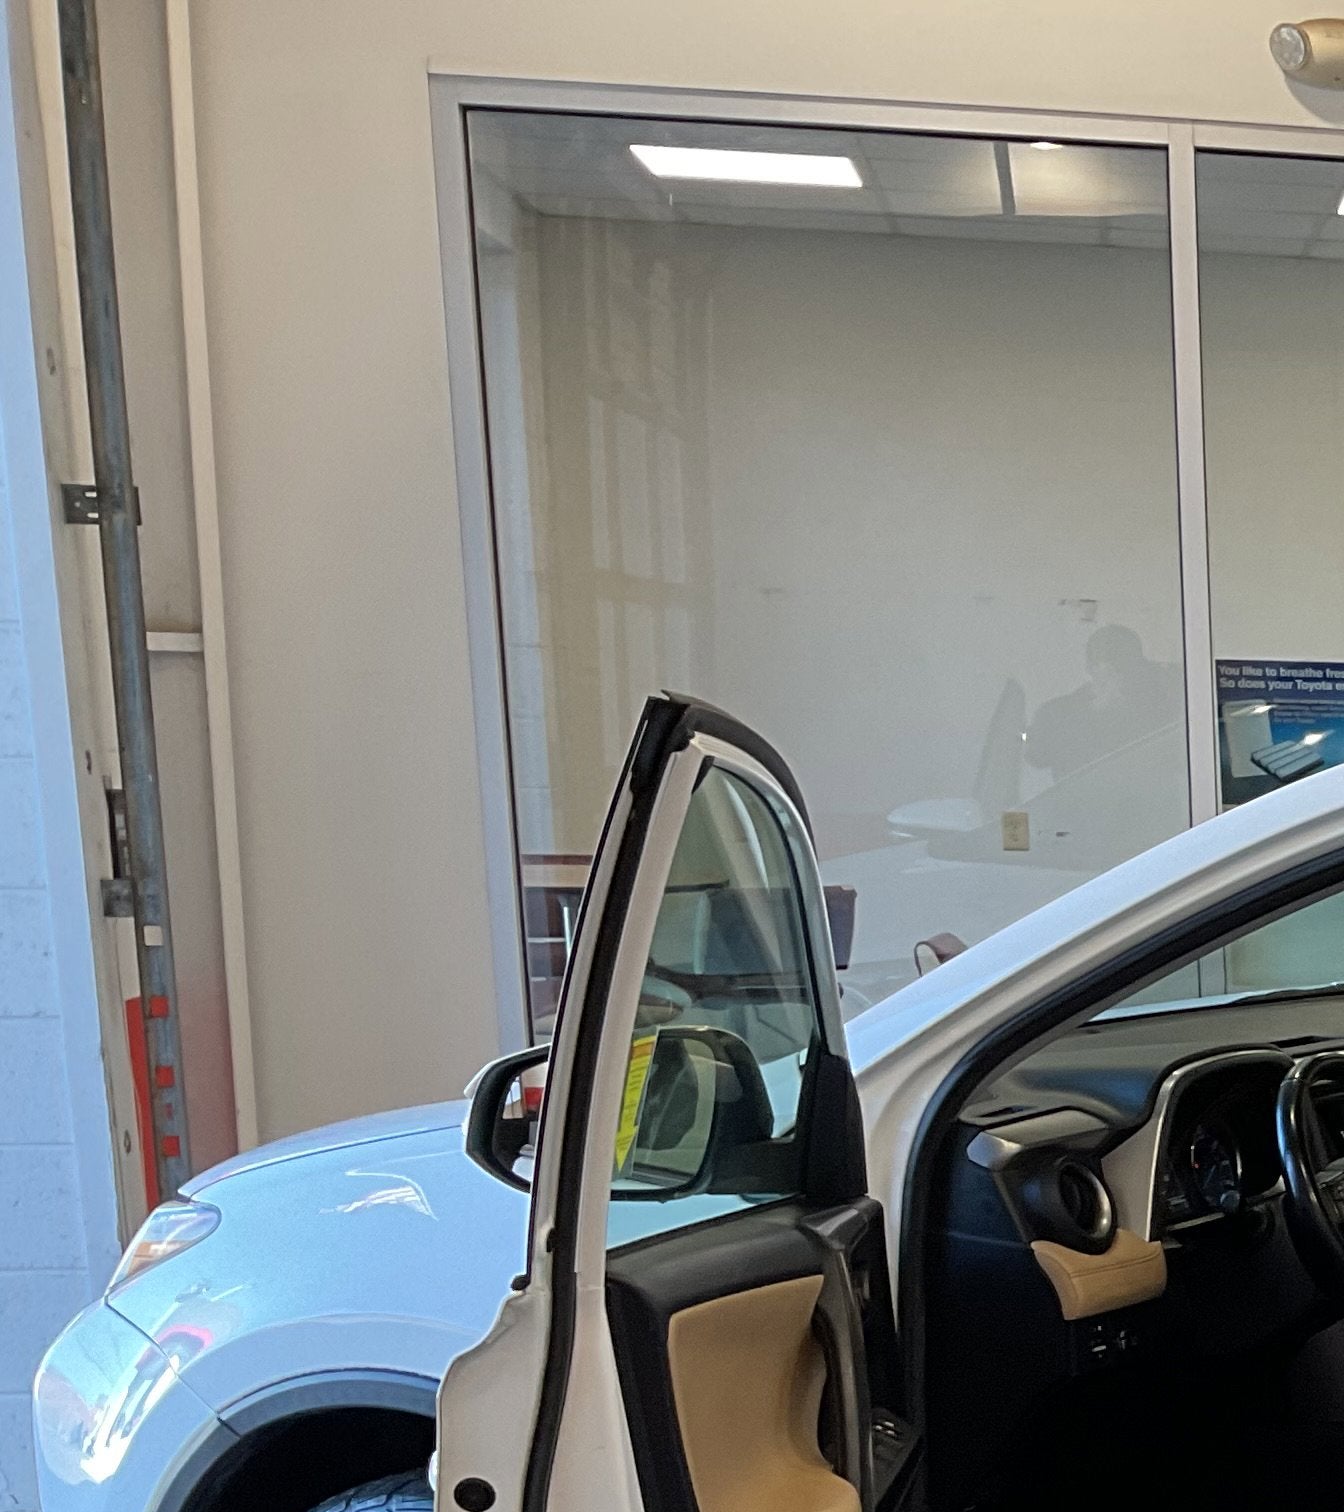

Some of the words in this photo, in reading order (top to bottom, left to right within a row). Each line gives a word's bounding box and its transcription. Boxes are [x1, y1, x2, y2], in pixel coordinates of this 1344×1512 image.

[1218, 665, 1240, 677] You
[1242, 666, 1263, 677] like
[1265, 667, 1277, 677] to
[1280, 667, 1324, 678] breathe
[1219, 677, 1236, 689] So
[1238, 678, 1266, 689] does
[1268, 680, 1294, 692] your
[1295, 679, 1333, 693] Toyota
